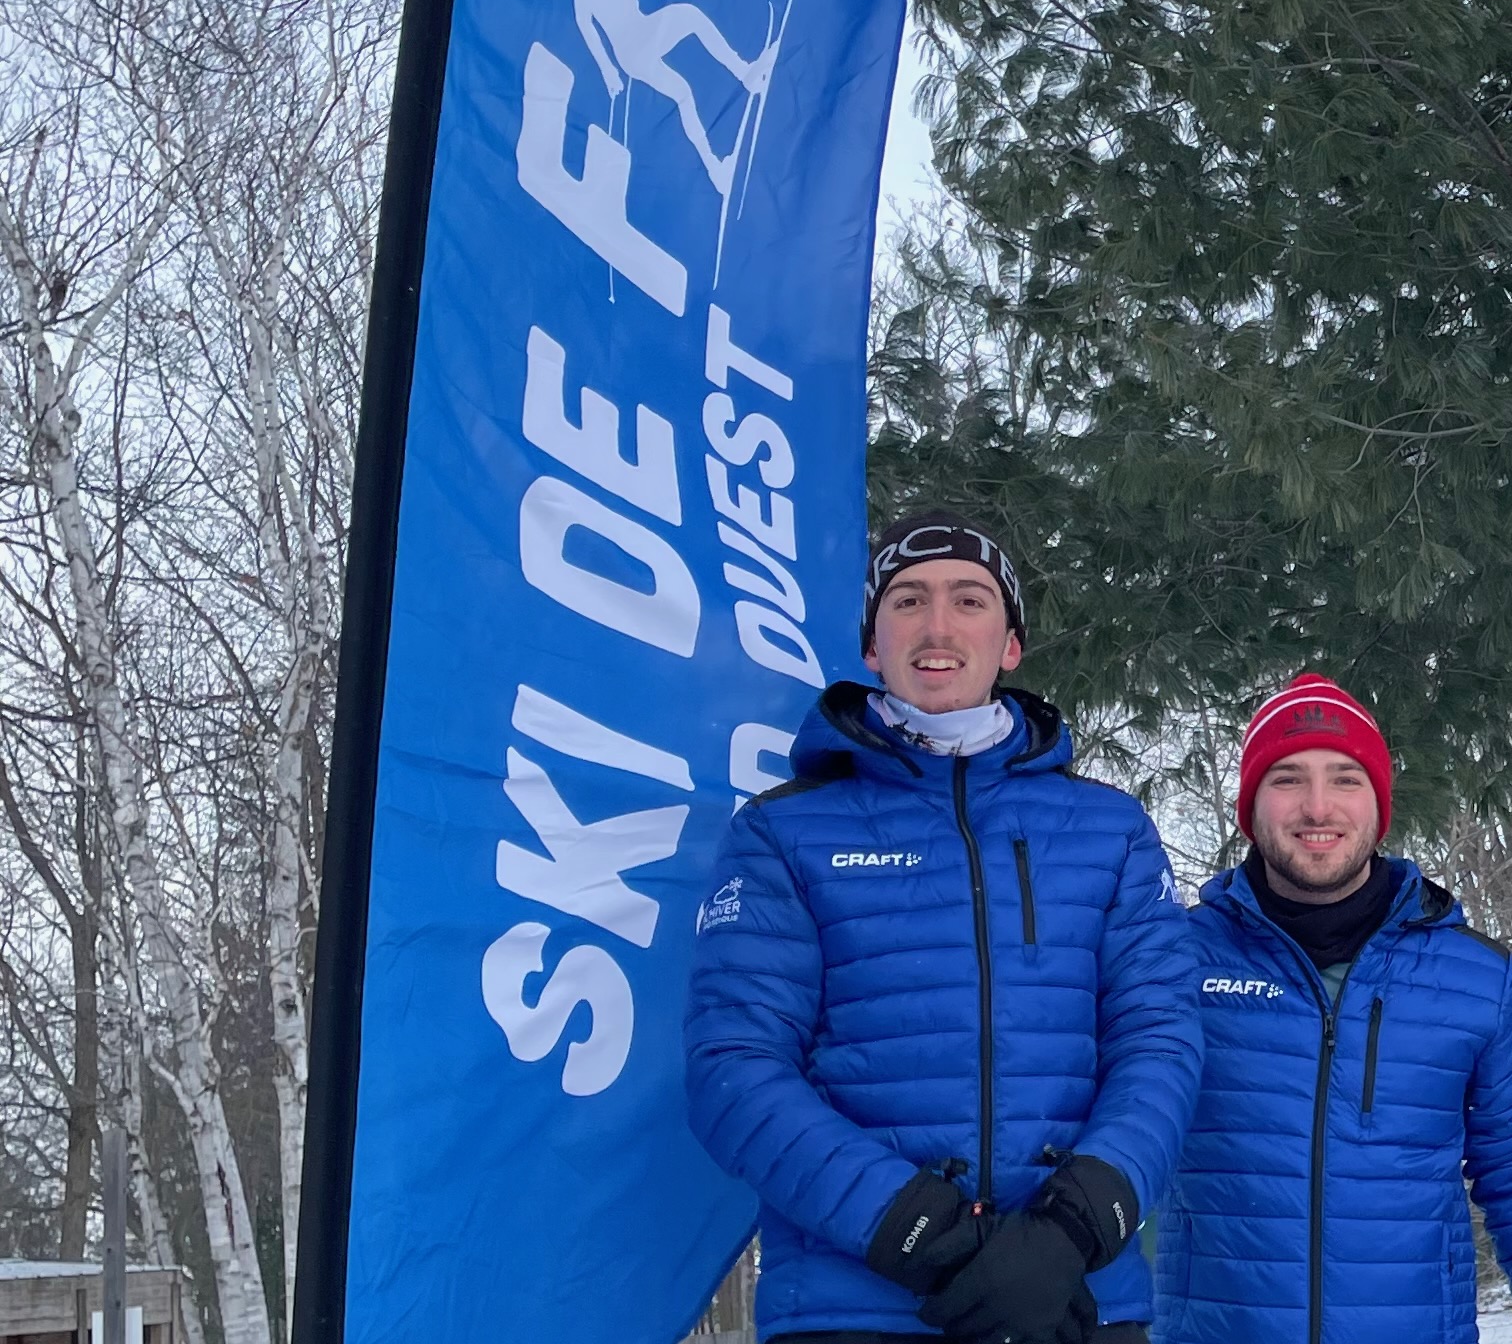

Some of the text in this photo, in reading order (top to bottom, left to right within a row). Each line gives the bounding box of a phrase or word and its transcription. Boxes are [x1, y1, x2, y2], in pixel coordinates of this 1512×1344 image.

[519, 325, 701, 659] DE
[703, 303, 826, 689] OUEST
[481, 684, 694, 1096] SKI
[832, 853, 903, 867] CRAFT
[1202, 978, 1267, 995] CRAFT
[902, 1215, 929, 1253] KOMBI
